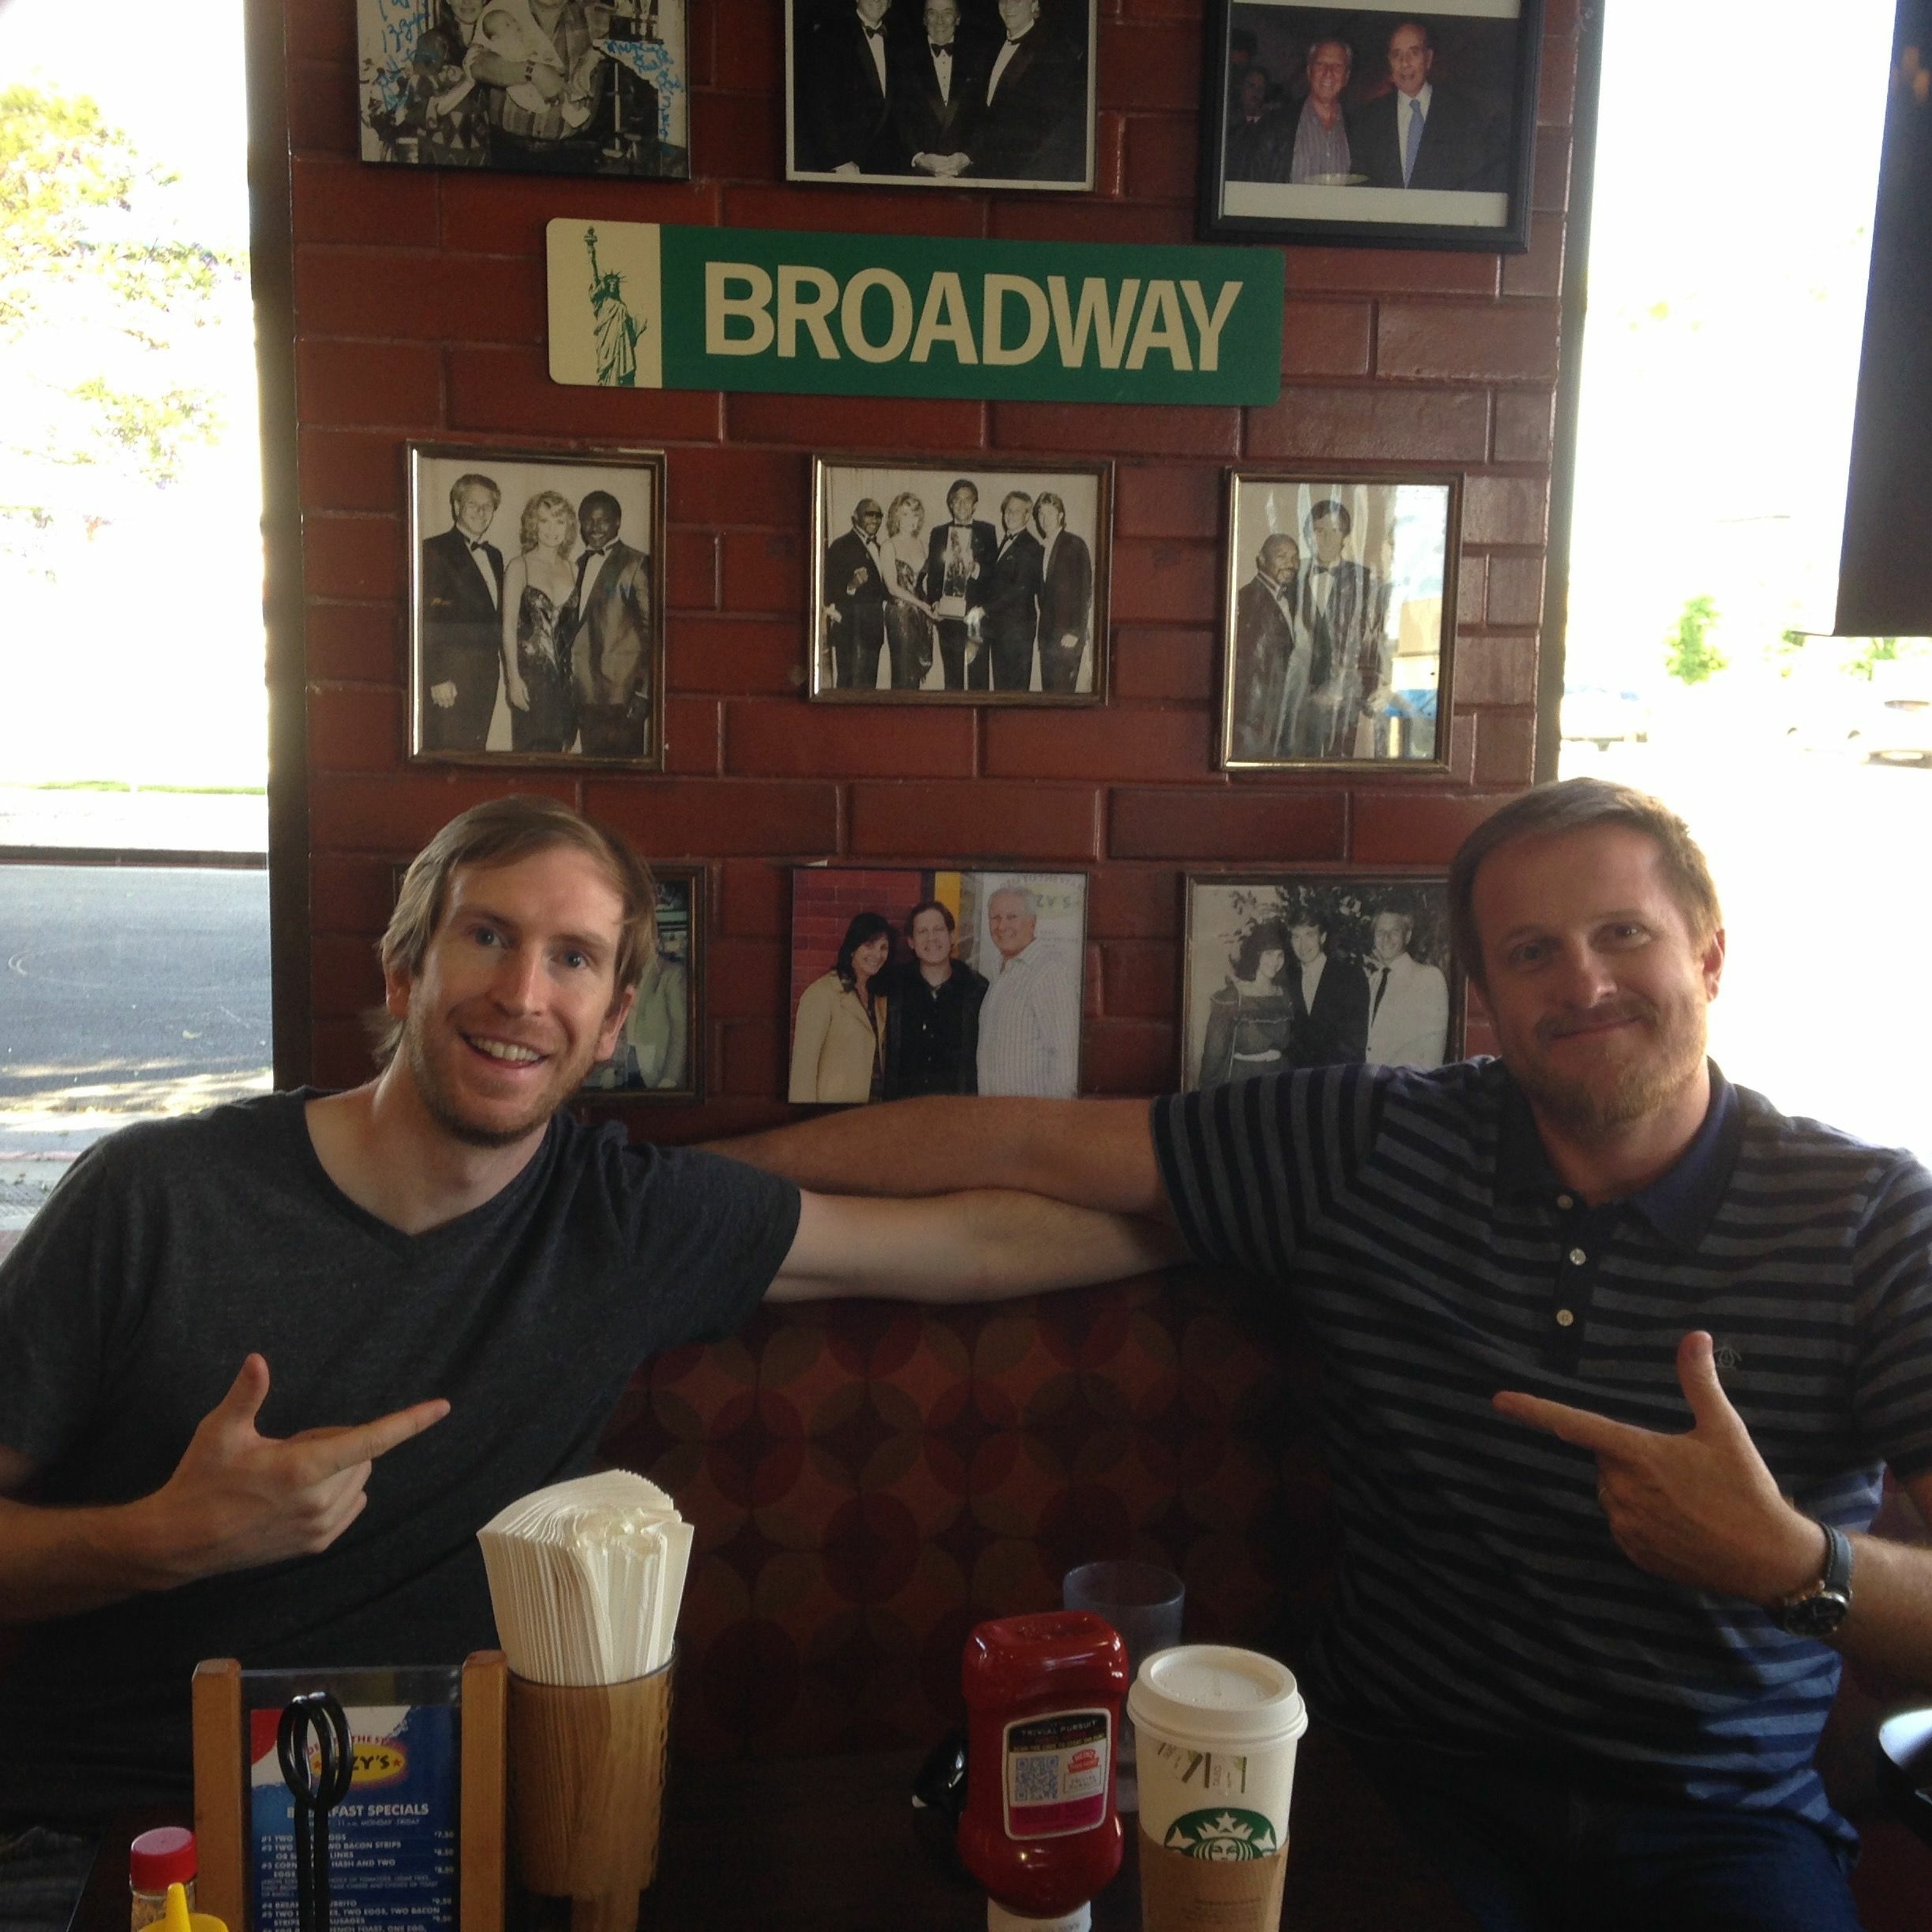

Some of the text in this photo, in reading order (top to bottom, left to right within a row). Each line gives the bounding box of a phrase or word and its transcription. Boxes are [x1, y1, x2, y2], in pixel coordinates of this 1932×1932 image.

[705, 261, 1244, 372] BROADWAY
[1059, 1719, 1097, 1733] PURSUIT
[352, 1755, 390, 1770] ZY'S
[368, 1803, 429, 1816] SPECIALS
